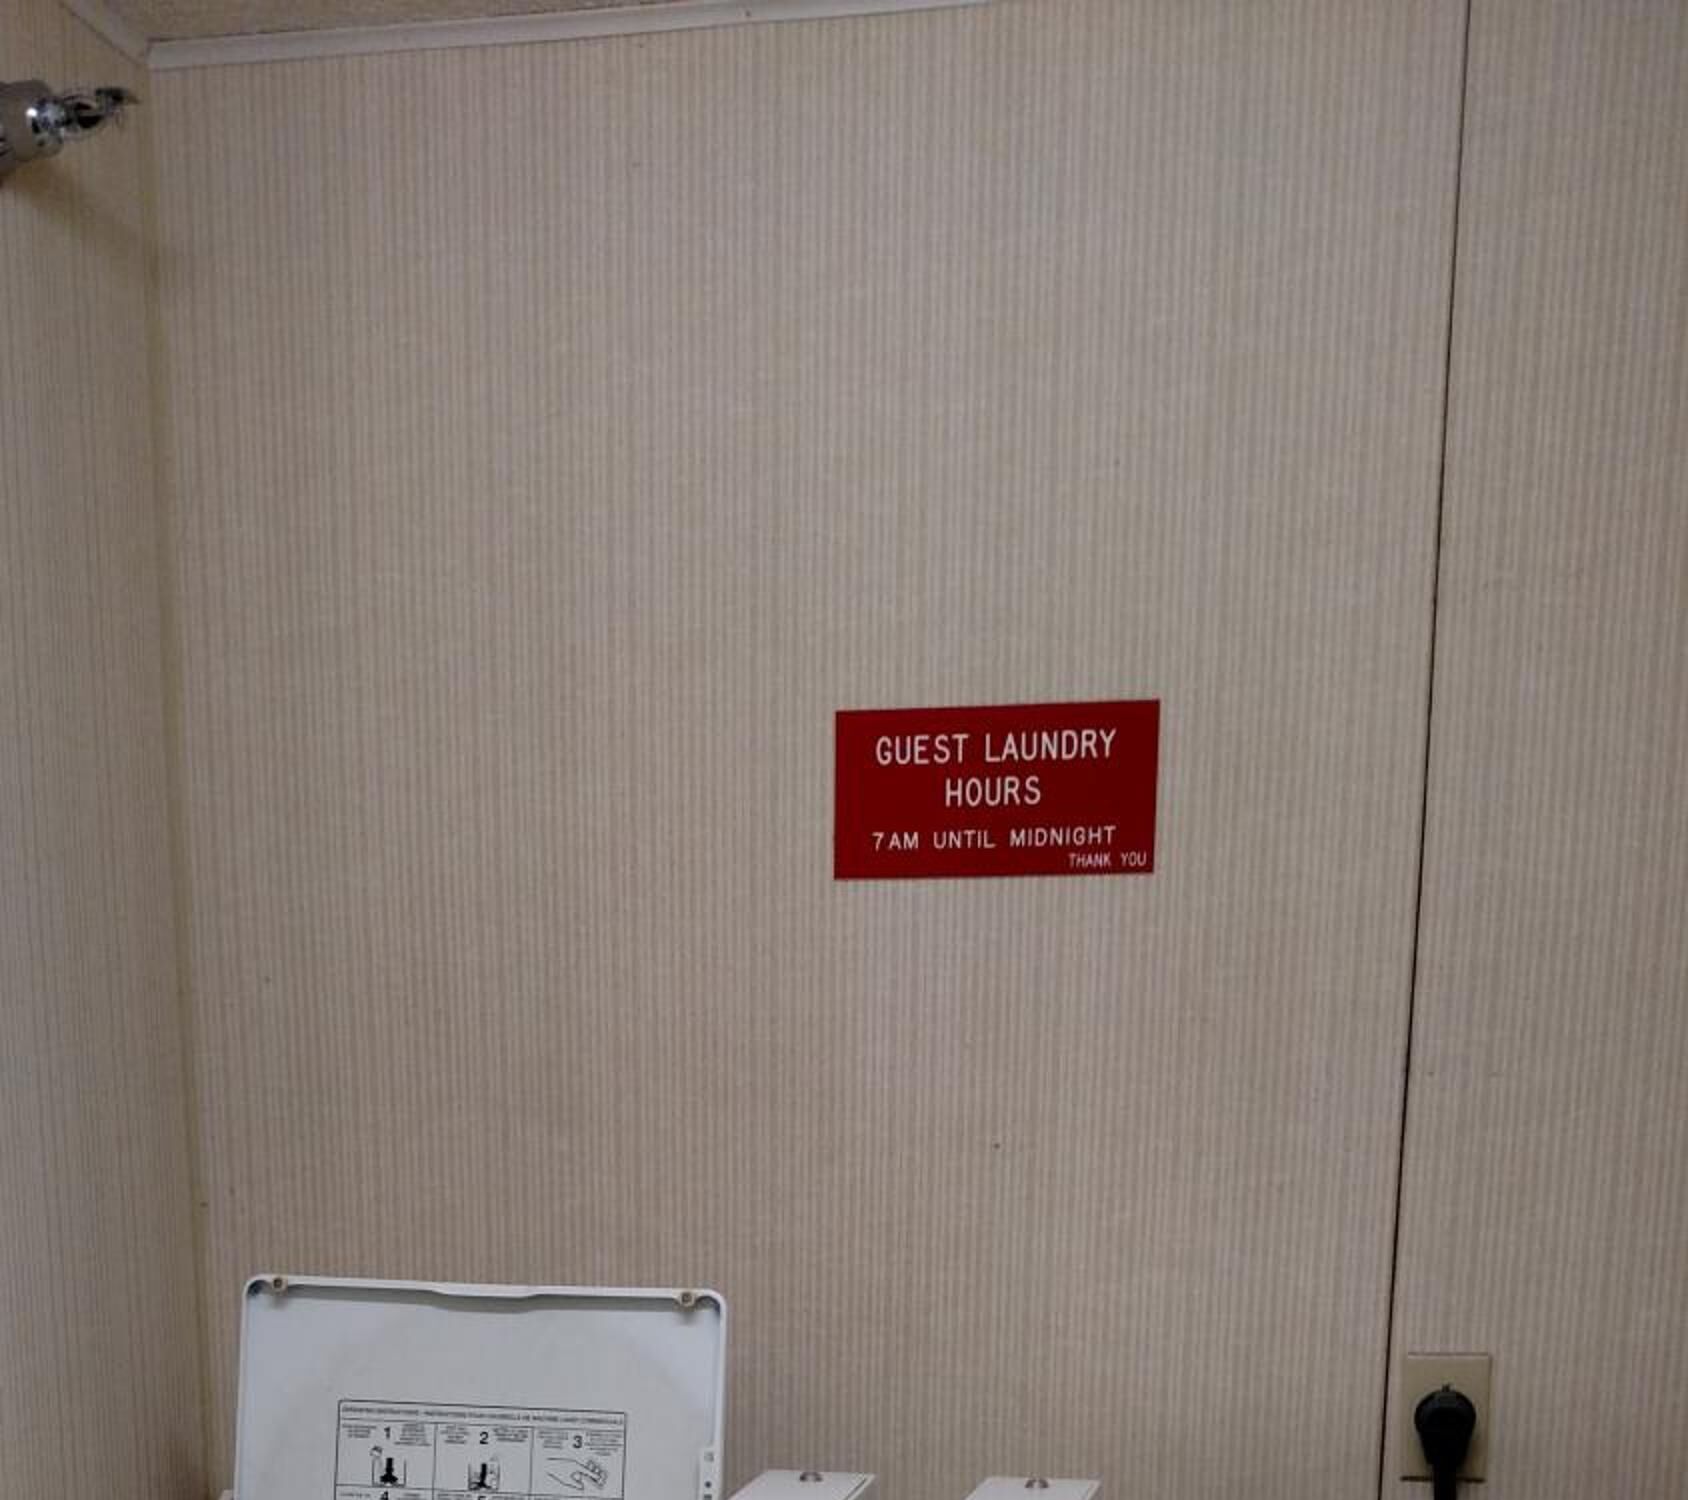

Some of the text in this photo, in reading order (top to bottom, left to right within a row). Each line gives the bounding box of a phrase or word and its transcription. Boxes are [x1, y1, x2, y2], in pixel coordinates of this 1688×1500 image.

[876, 728, 1117, 765] GUEST LAUNDRY
[945, 776, 1041, 807] HOURS
[872, 825, 1117, 851] 7AM UNTIL MIDNIGHT
[1069, 852, 1147, 867] THANK YOU
[383, 1426, 391, 1440] 1
[479, 1431, 489, 1445] 2
[572, 1435, 583, 1449] 3
